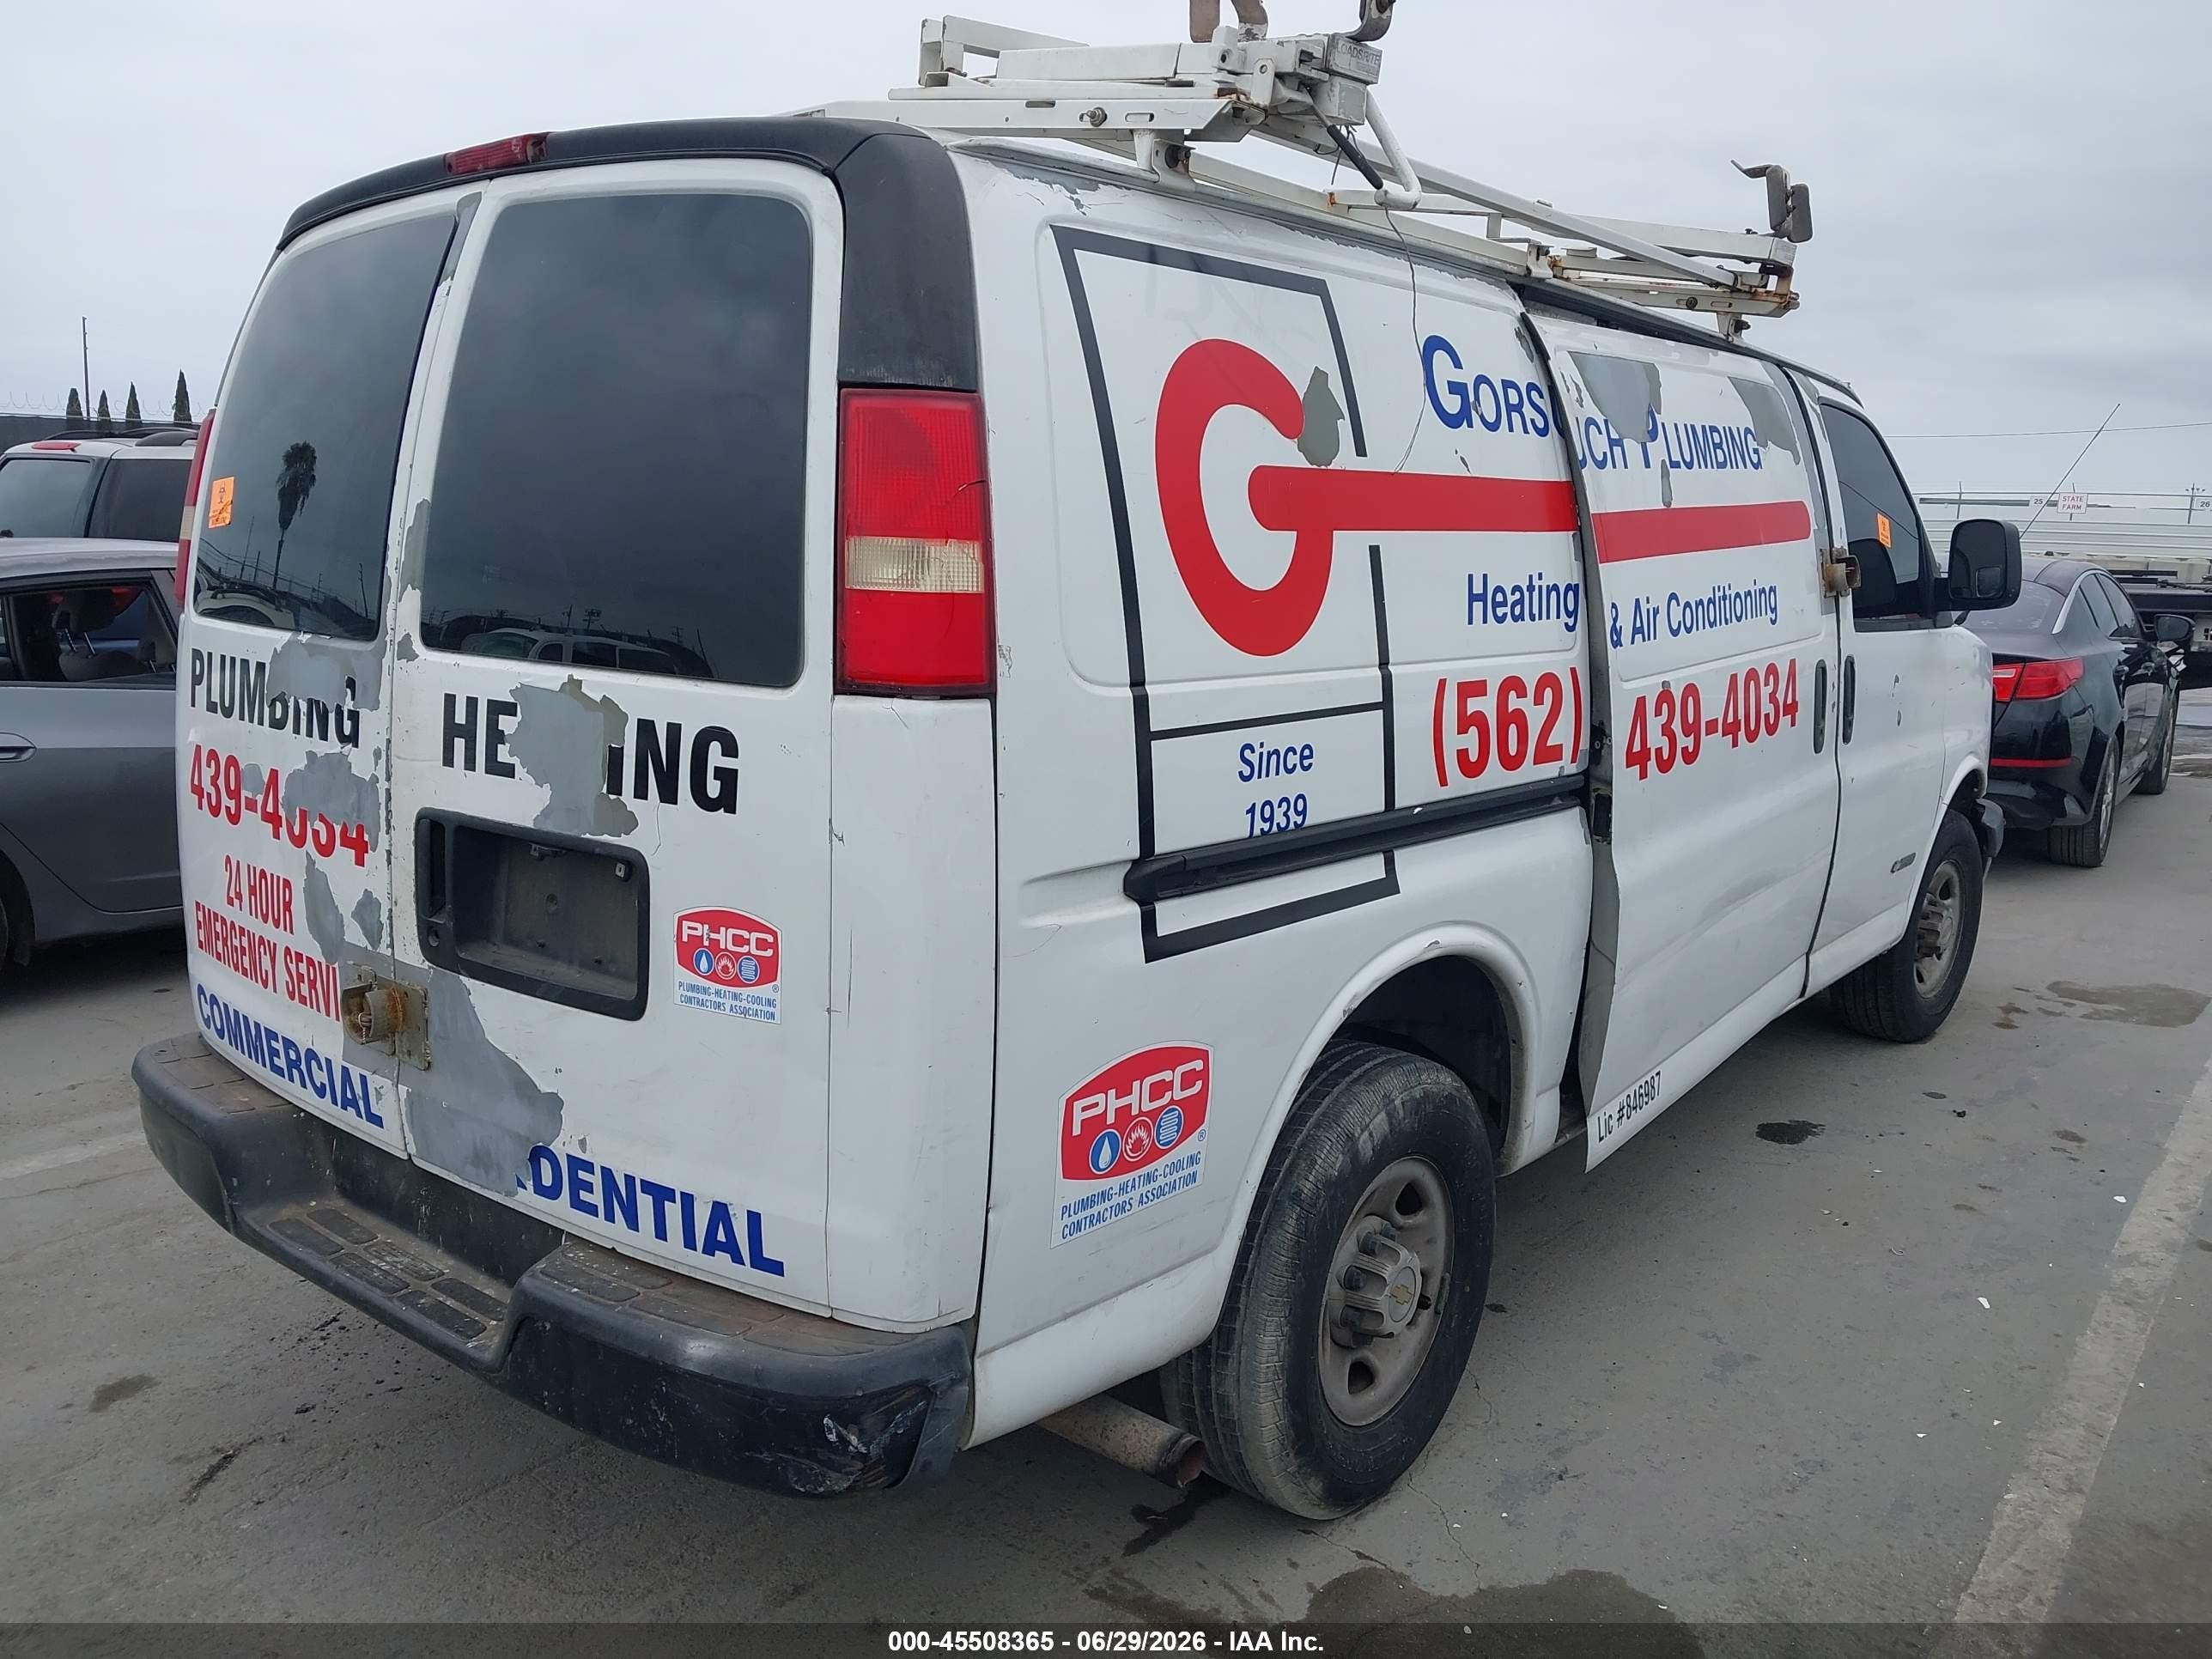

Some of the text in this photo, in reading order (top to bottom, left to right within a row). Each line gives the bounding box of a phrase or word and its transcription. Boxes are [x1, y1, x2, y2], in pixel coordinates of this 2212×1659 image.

[1468, 572, 1778, 649] Heating & Air Conditioning
[441, 692, 740, 815] HEING
[1432, 658, 1799, 787] (562) 439-4034
[1237, 741, 1315, 782] Since
[1245, 793, 1308, 840] 1939
[224, 854, 295, 935] 24 HOUR
[195, 901, 341, 1022] EMERGENCY SERVI
[682, 920, 774, 957] PHCC
[678, 981, 777, 1009] PLUMBING-HEATING-COOLING
[679, 994, 775, 1021] CONTRACTORS ASSOCIATION
[197, 983, 385, 1129] COMMERCIAL
[1072, 1059, 1204, 1137] PHCC
[1597, 1070, 1661, 1144] Lic #846987
[529, 1144, 785, 1278] DENTIAL
[1060, 1151, 1201, 1221] PLUMBING-HEATING-COOLING
[1061, 1170, 1198, 1240] CONTRACTORS ASSOCIATION
